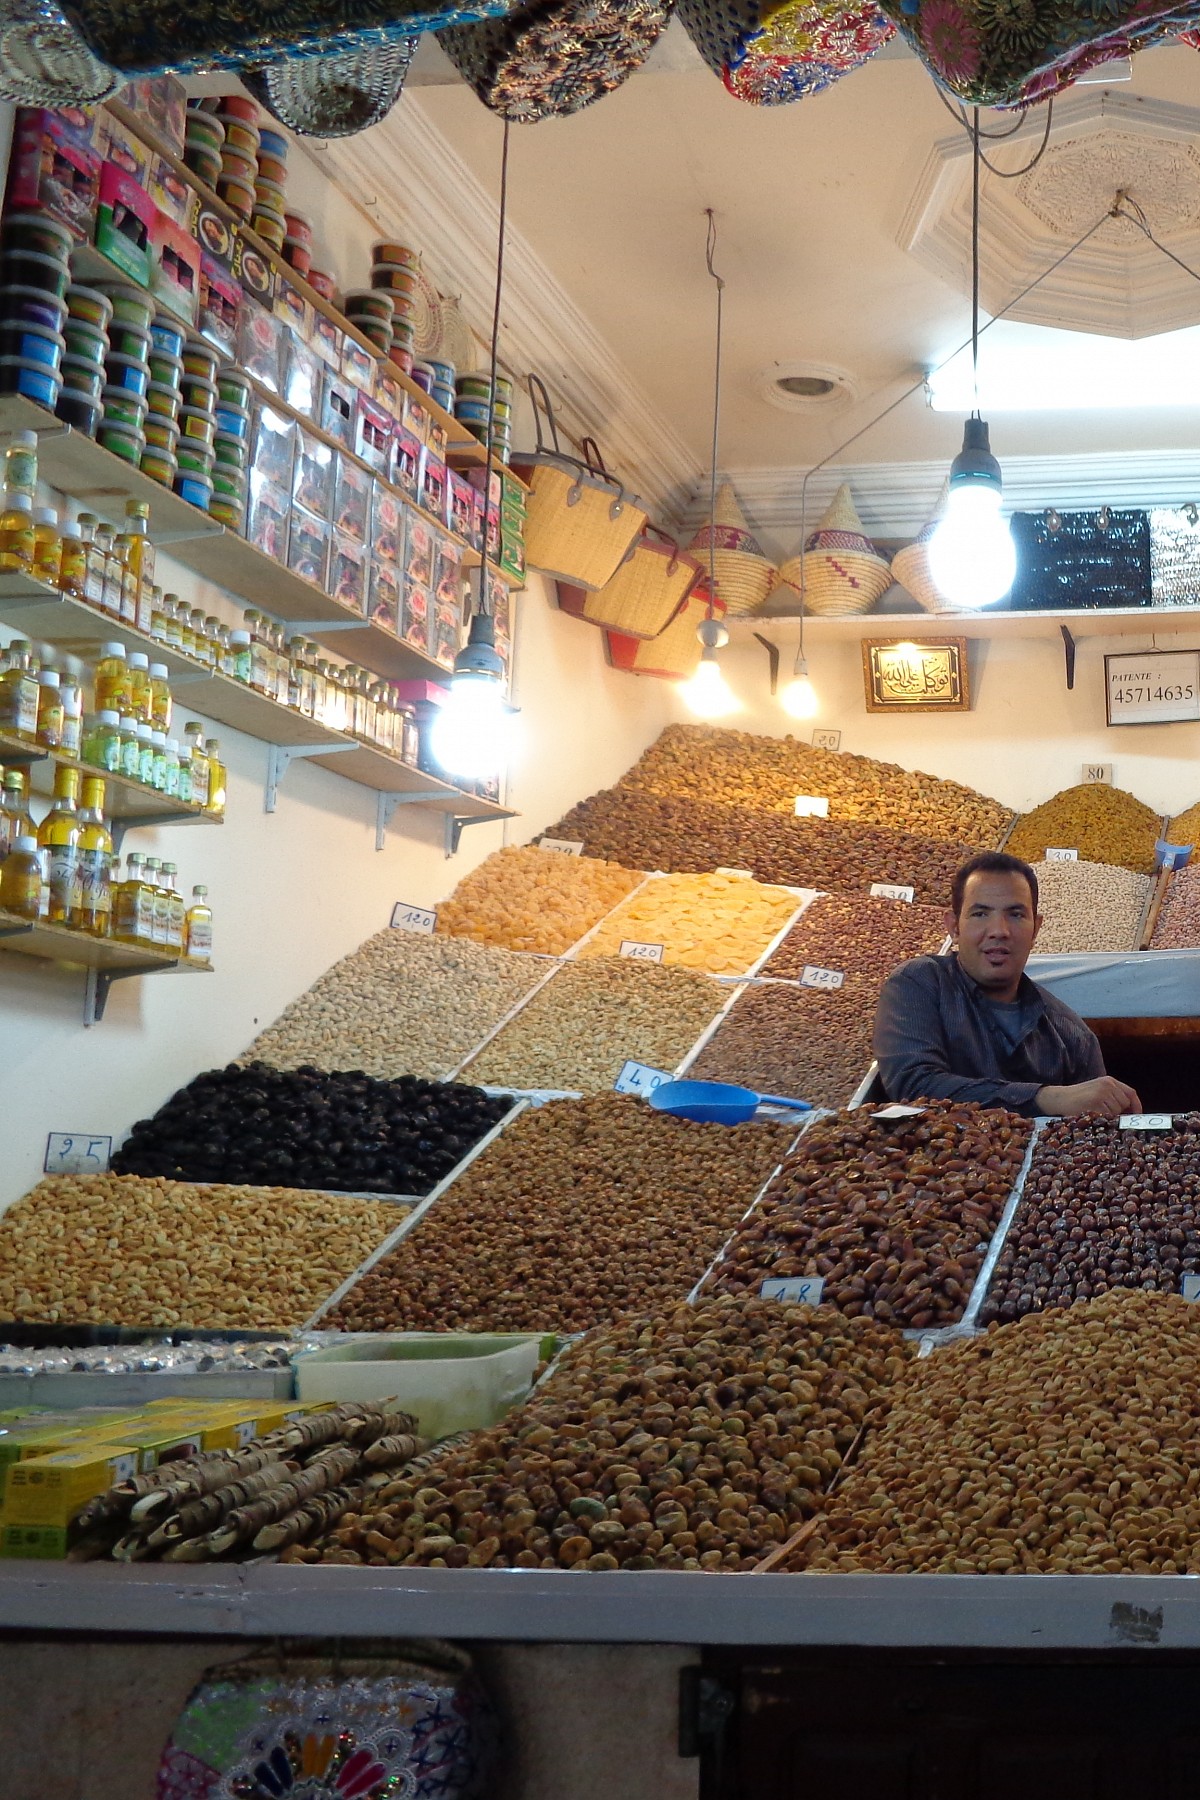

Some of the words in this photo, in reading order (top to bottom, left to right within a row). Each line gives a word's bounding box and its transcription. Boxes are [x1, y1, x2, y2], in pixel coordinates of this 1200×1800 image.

[1112, 673, 1152, 682] PATENTE
[1115, 685, 1193, 703] 45714635
[1088, 768, 1104, 779] 80
[402, 913, 431, 927] 120
[629, 947, 657, 957] 120
[810, 971, 839, 984] 120
[629, 1068, 661, 1089] 40
[1129, 1117, 1164, 1127] 80
[59, 1139, 103, 1164] 25
